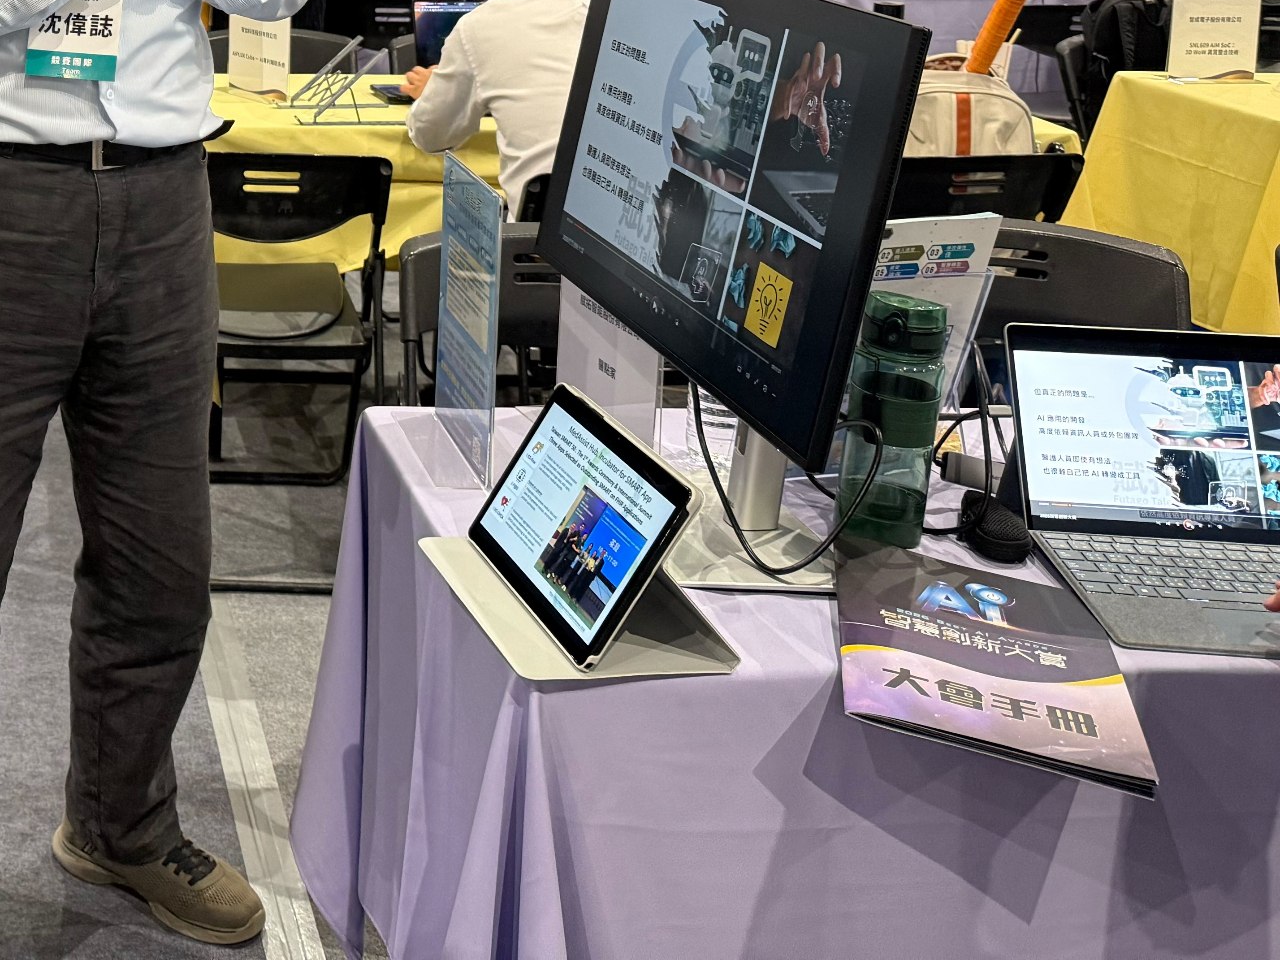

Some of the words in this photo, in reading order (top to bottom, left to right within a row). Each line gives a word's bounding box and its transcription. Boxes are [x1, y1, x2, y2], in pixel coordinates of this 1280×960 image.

[38, 12, 114, 38] 沈偉誌
[879, 608, 1068, 669] 智慧創新大賞
[882, 667, 1100, 739] 大會手冊
